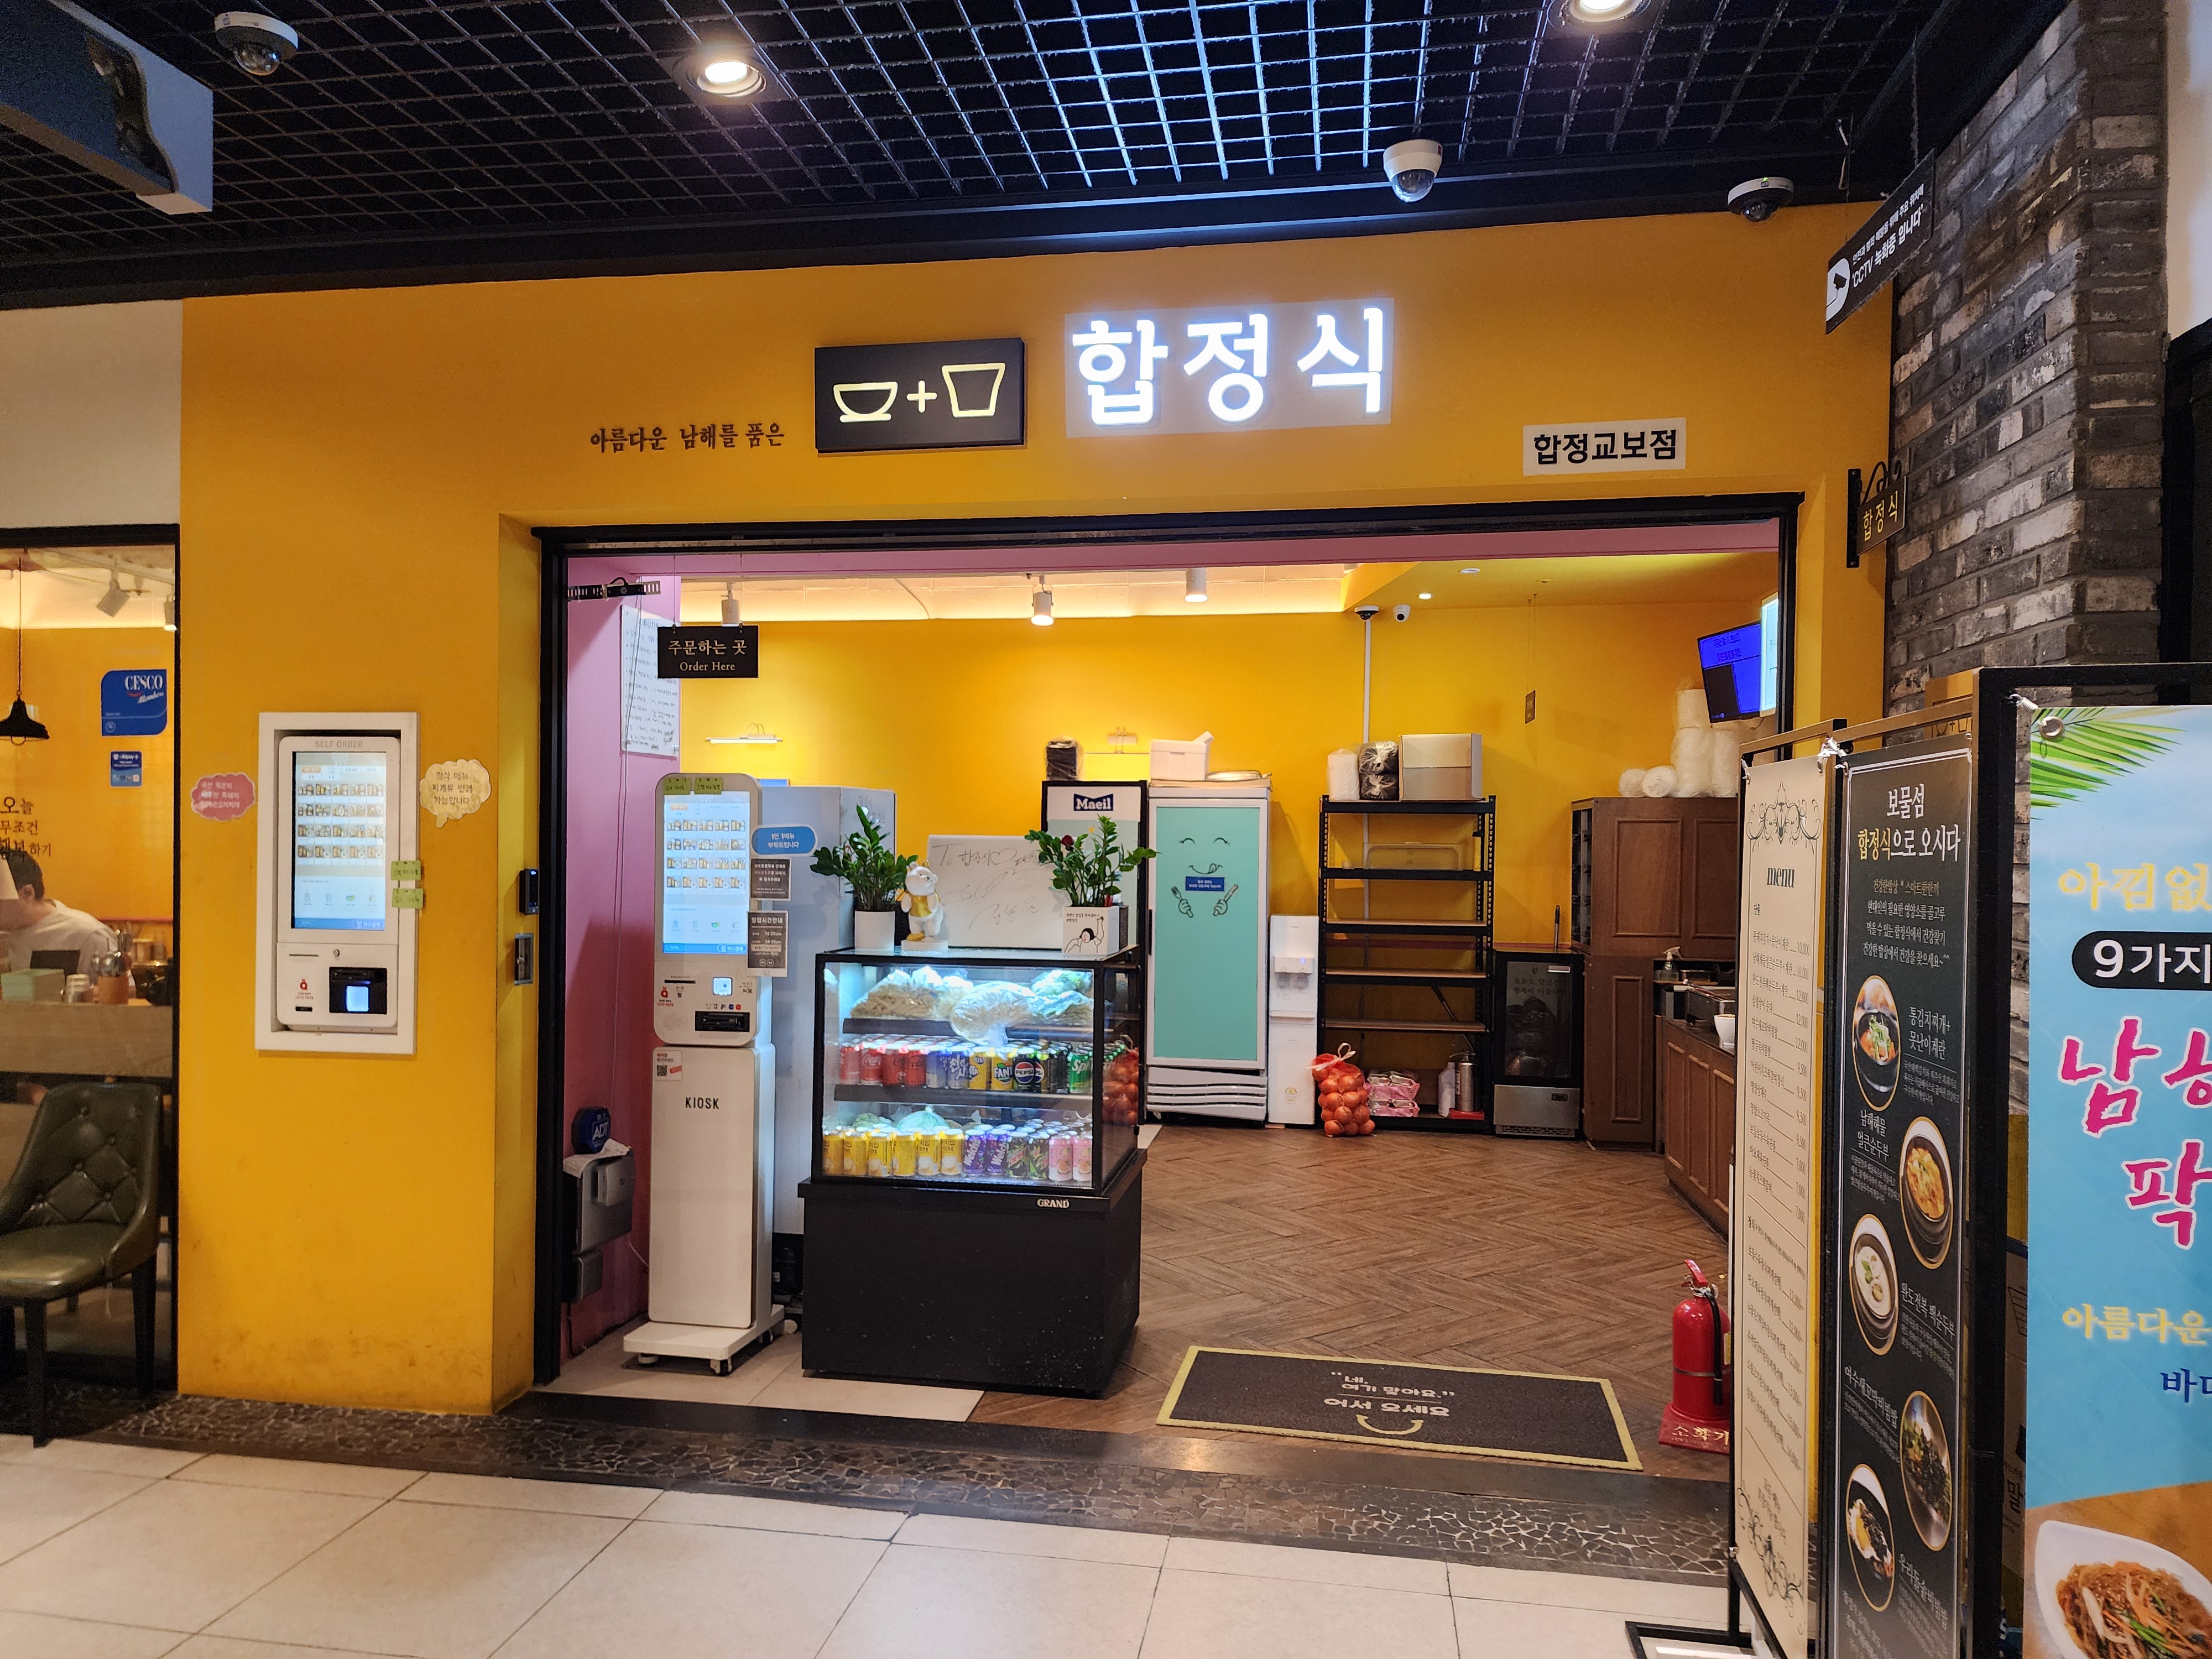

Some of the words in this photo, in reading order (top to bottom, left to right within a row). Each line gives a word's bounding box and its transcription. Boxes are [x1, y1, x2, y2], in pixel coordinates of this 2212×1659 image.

[1874, 232, 1896, 266] 녹화중
[1072, 307, 1384, 426] 합정식
[590, 427, 667, 453] 아름다운
[680, 424, 738, 450] 남해를
[745, 422, 785, 448] 품은
[1533, 429, 1678, 466] 합정교보점
[1863, 490, 1898, 541] 합정식
[667, 640, 727, 656] 주문하는
[732, 640, 747, 656] 곳
[680, 661, 708, 671] Order
[712, 661, 735, 671] Here
[124, 674, 163, 691] CESCO
[336, 740, 363, 749] ORDER
[436, 771, 450, 780] 정식
[454, 771, 468, 780] 메뉴
[0, 797, 33, 815] 오늘
[434, 796, 469, 805] 가능합니다
[1076, 797, 1112, 810] Maeil
[1887, 783, 1925, 818] 보물섬
[1858, 827, 1916, 862] 합정식으로
[1919, 824, 1961, 862] 오시다
[1766, 867, 1795, 888] menu
[1887, 902, 1903, 917] 필요한
[1927, 905, 1945, 921] 골고루
[1866, 921, 1876, 936] 먹을
[1877, 924, 1883, 936] 수
[1895, 925, 1922, 943] 합정식에서
[1863, 941, 1878, 957] 건강한
[1900, 947, 1916, 965] 건강을
[1909, 1031, 1947, 1060] 못난이계란
[685, 1097, 719, 1109] KIOSK
[593, 1121, 609, 1140] ADT
[1860, 1109, 1886, 1138] 남해해물
[1857, 1131, 1890, 1162] 얼큰순두부
[1037, 1199, 1070, 1208] GRAND
[2062, 1303, 2212, 1345] 아름다운
[1342, 1383, 1377, 1393] 여기
[1324, 1397, 1371, 1411] 어서
[1381, 1401, 1450, 1417] 오세요
[1672, 1426, 1729, 1446] 소화기
